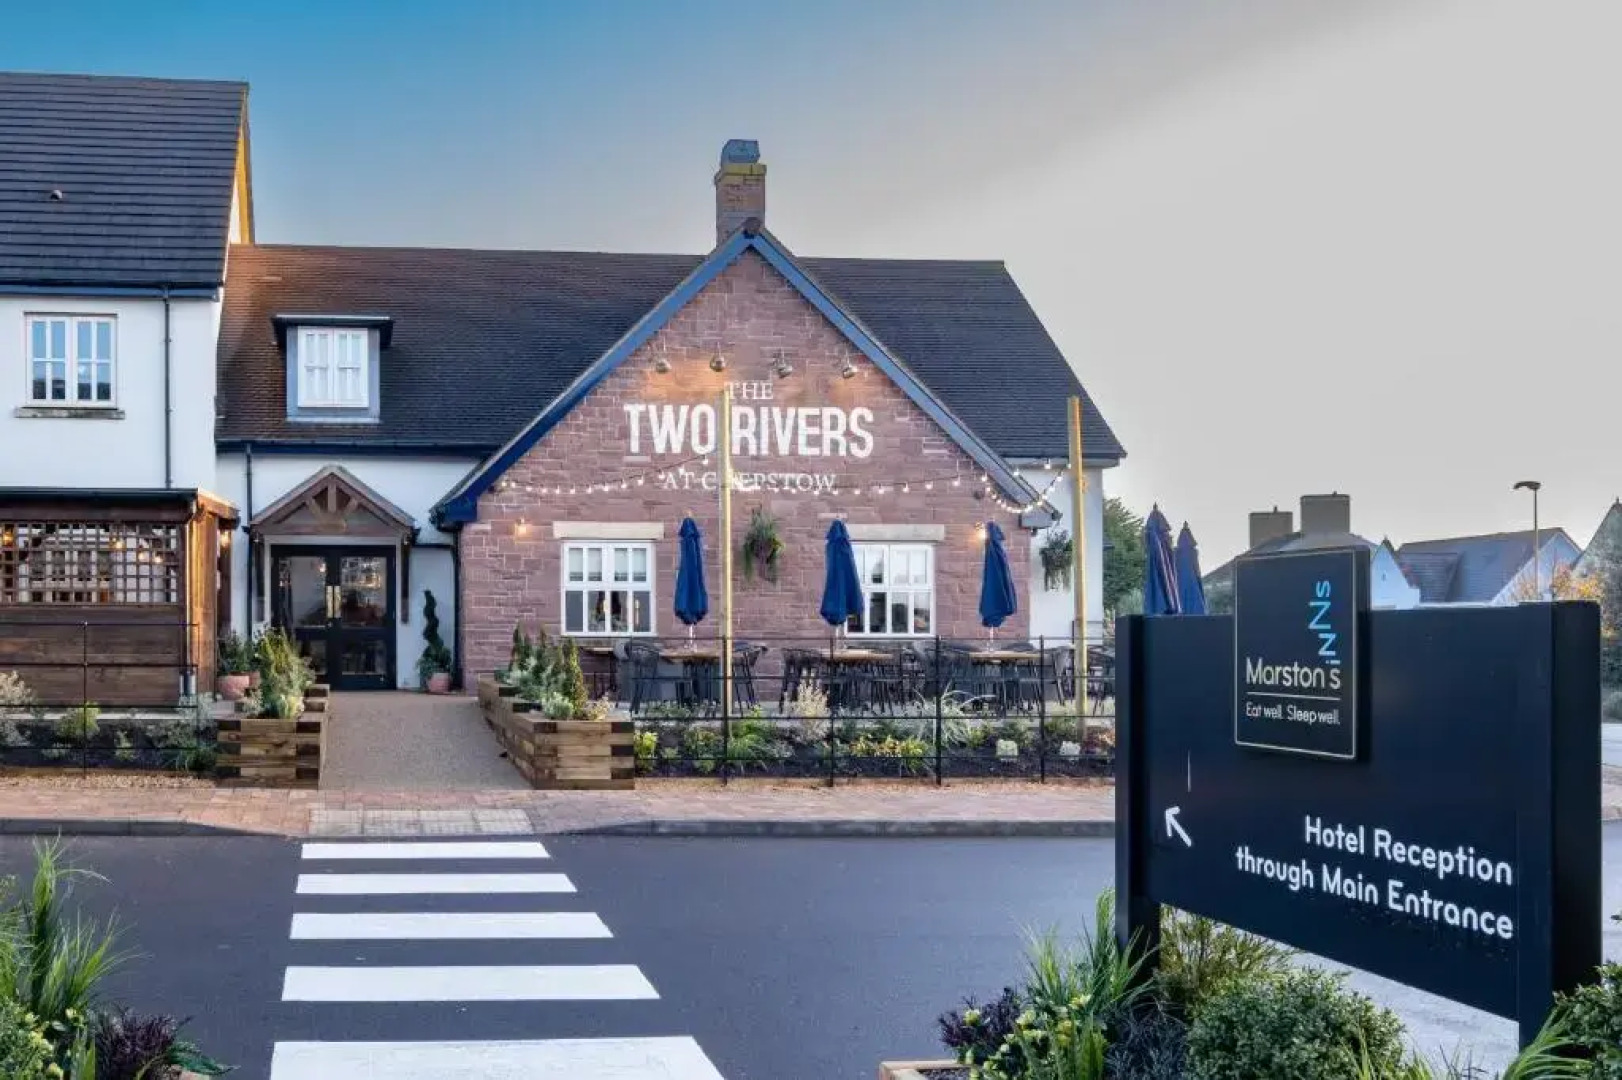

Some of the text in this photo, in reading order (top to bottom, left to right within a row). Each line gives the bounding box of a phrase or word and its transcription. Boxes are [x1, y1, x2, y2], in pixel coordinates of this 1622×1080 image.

[723, 381, 774, 400] THE
[623, 402, 874, 458] TWO RIVERS
[663, 471, 837, 492] AT CEPSTOW
[1245, 701, 1262, 717] Eat
[1287, 705, 1317, 725] Sleep
[1317, 708, 1341, 725] well.
[1305, 814, 1513, 886] Hotel Reception
[1236, 846, 1514, 939] through Main Entrance
